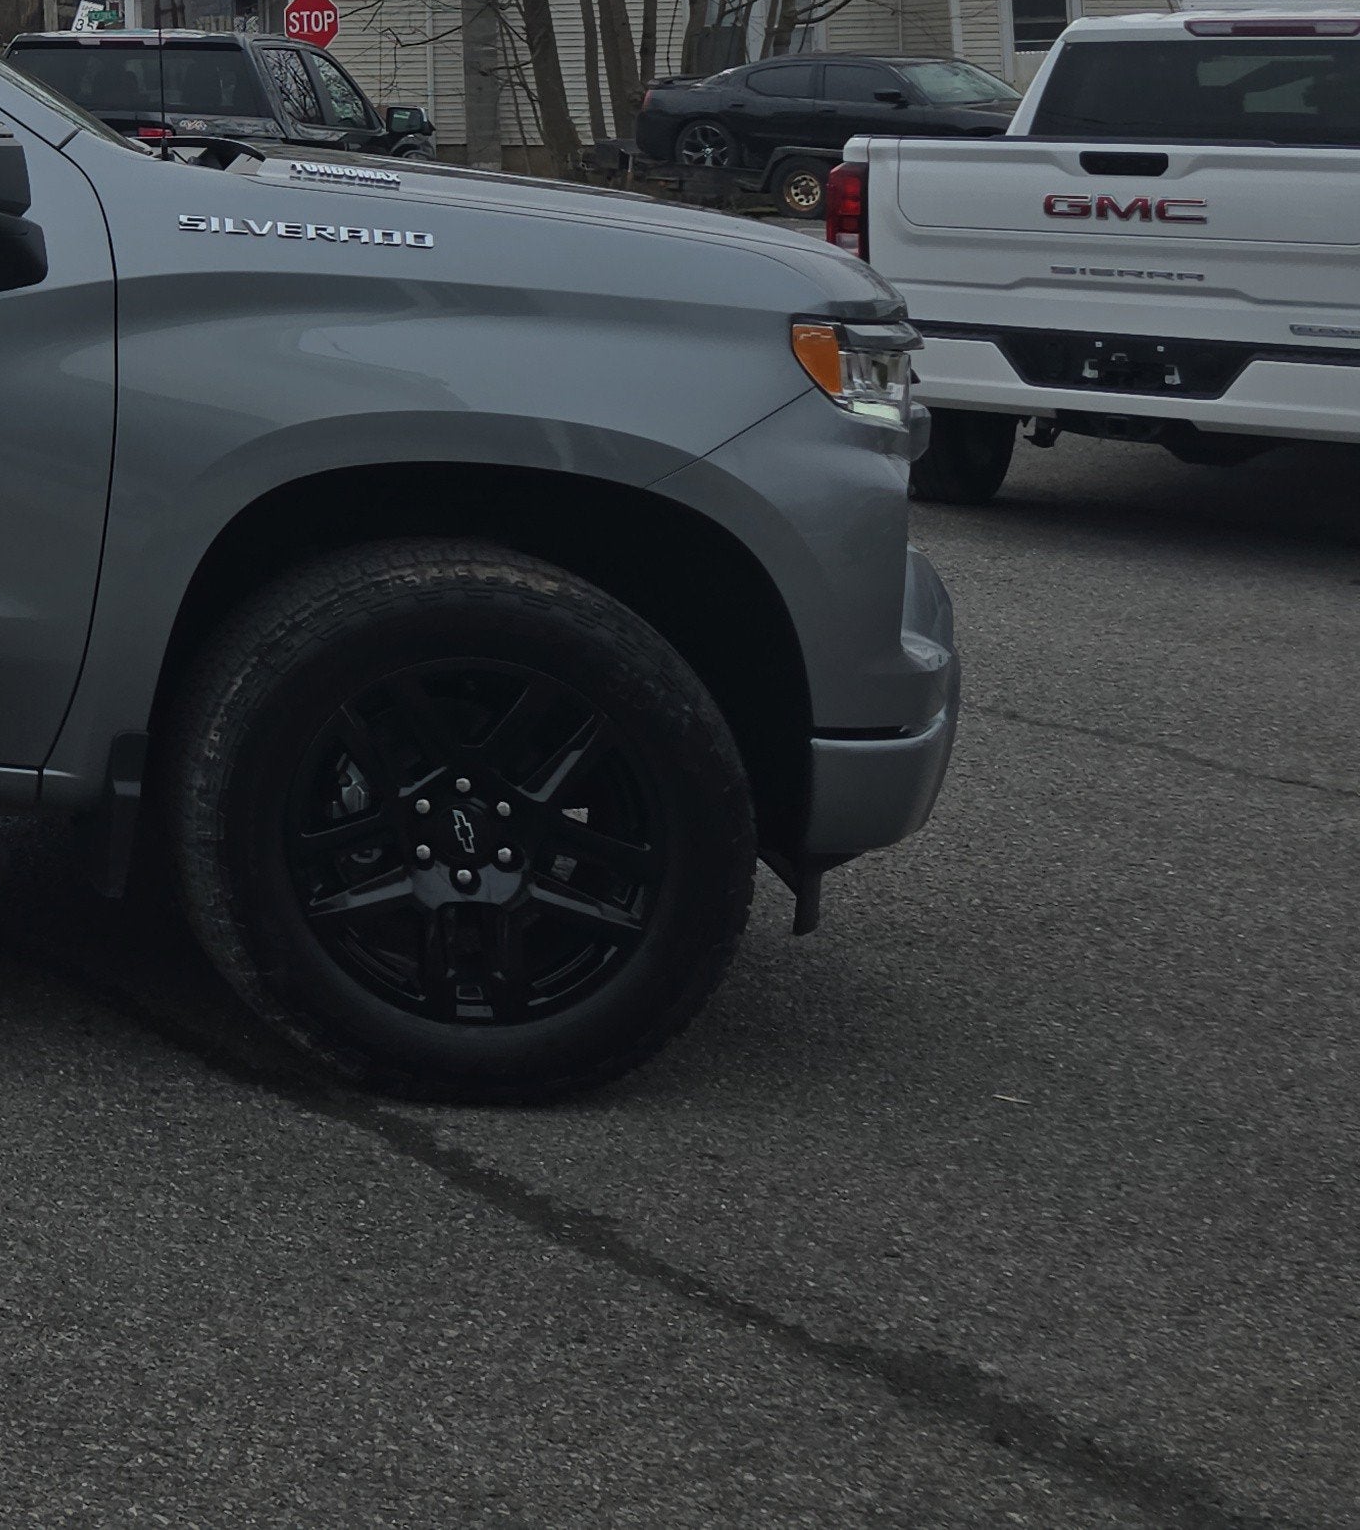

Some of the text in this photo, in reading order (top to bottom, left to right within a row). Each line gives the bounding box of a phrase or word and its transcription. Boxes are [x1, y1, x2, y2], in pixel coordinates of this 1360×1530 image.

[288, 10, 335, 33] STOP
[1043, 193, 1208, 224] GMC
[178, 214, 435, 249] SILVERADO
[1050, 265, 1205, 282] SIERRA
